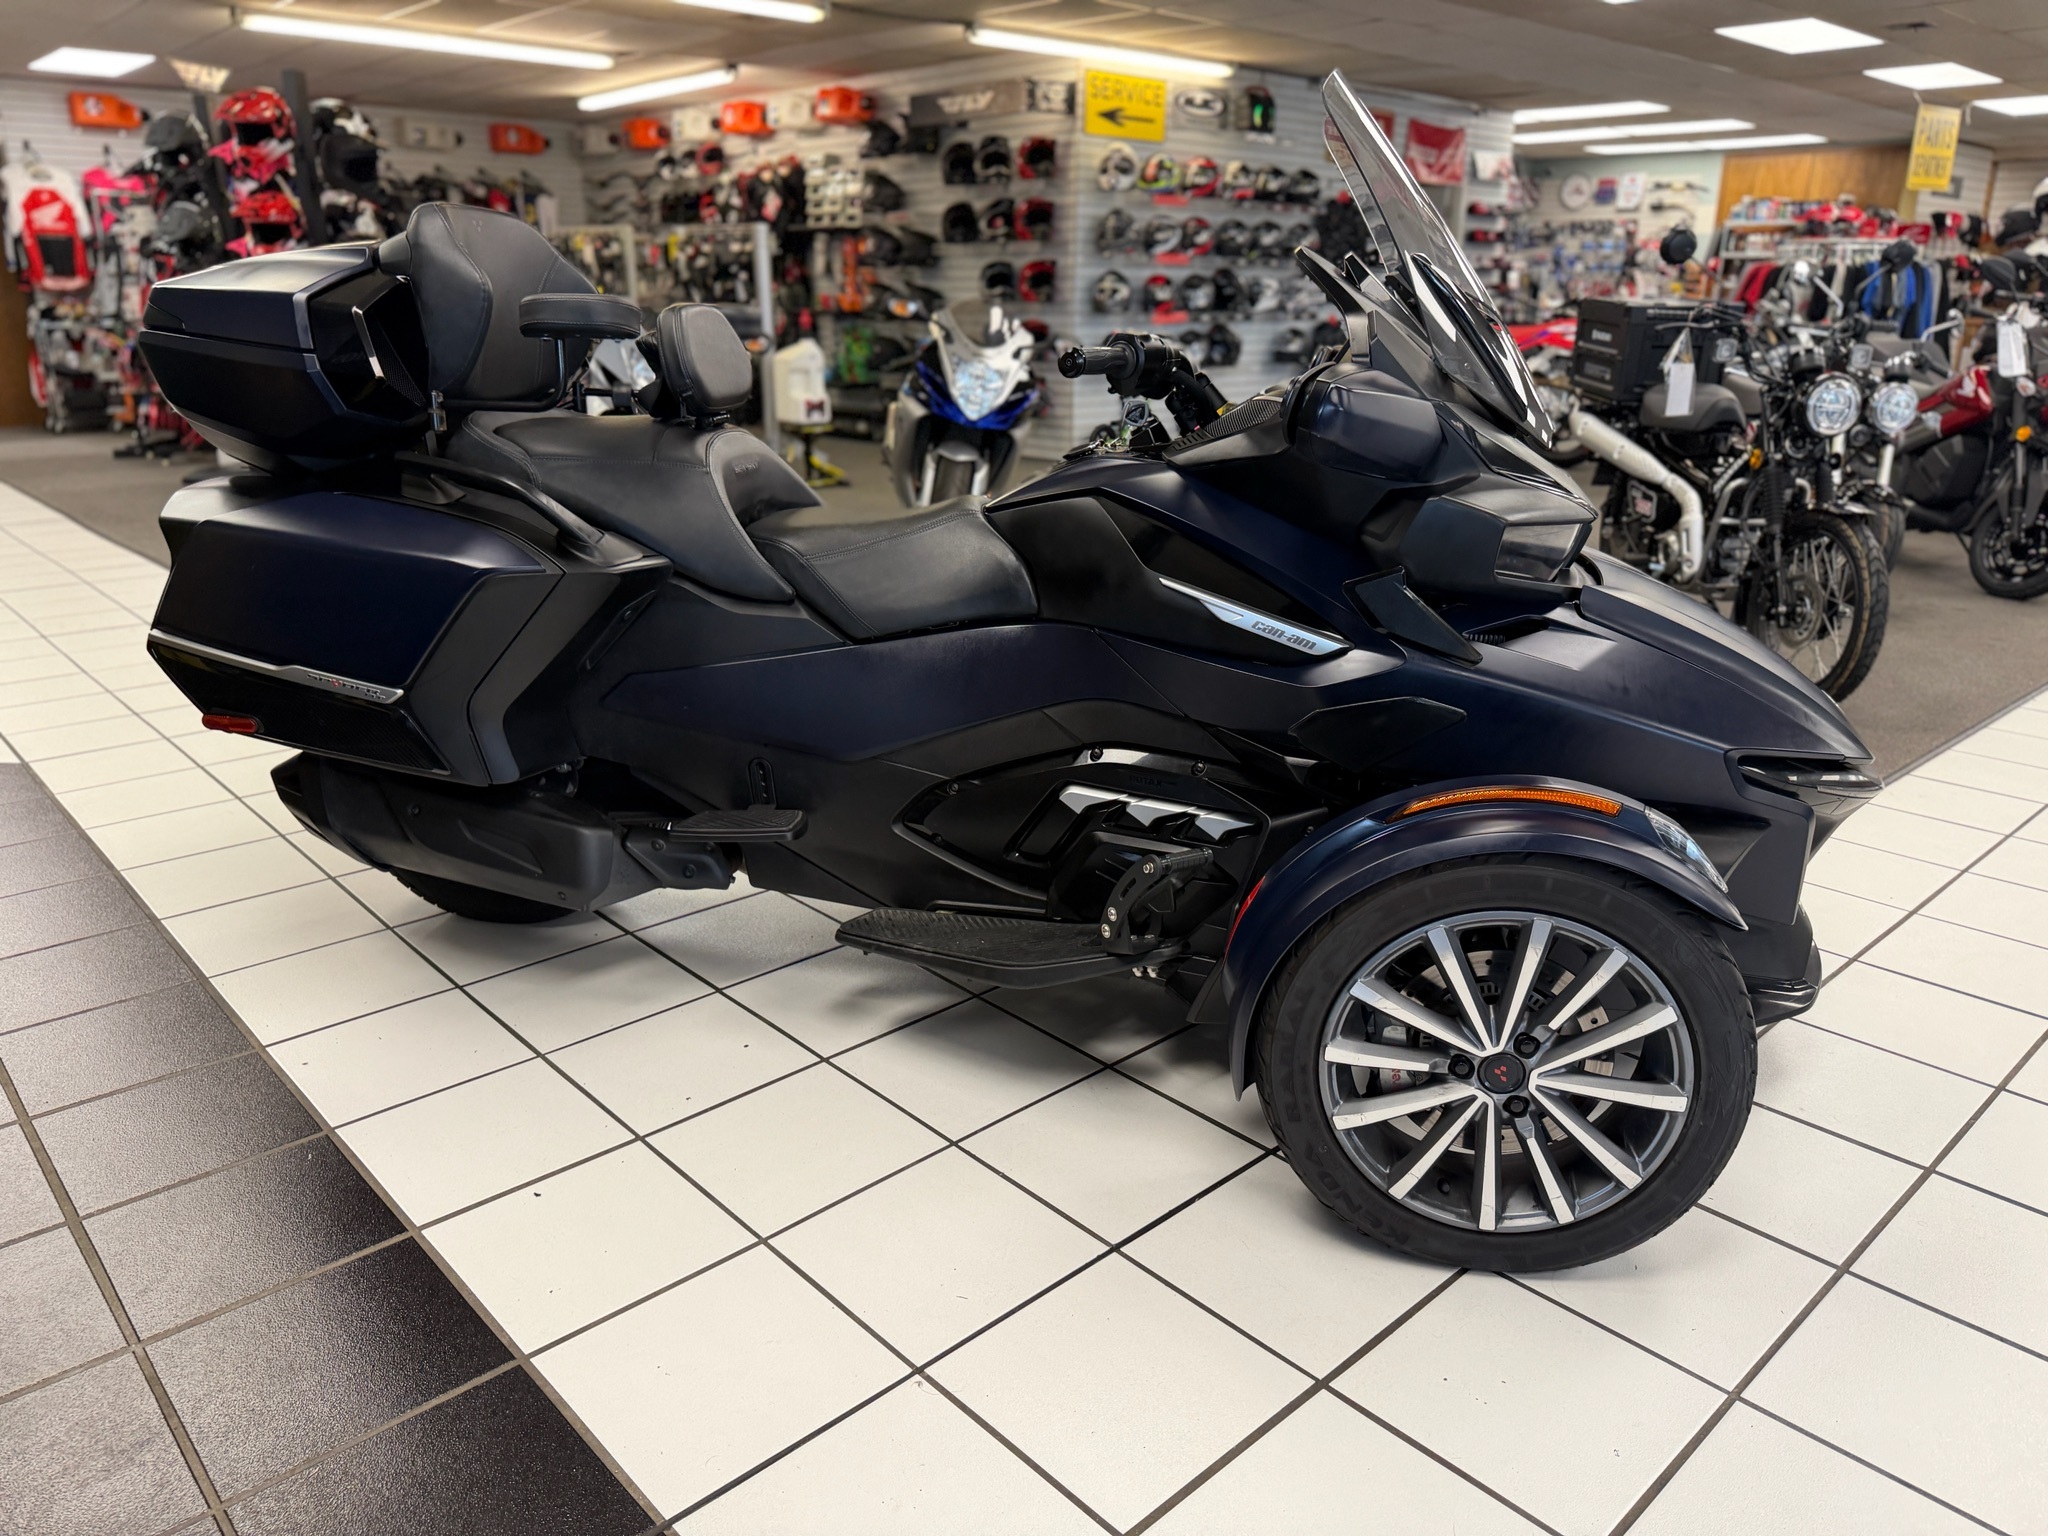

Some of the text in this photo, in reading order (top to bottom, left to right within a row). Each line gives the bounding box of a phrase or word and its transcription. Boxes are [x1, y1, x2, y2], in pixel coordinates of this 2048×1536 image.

[1090, 76, 1163, 107] SERVICE
[1917, 116, 1955, 149] PARTS
[1251, 620, 1317, 650] can-am
[1303, 1141, 1411, 1245] KENDA
